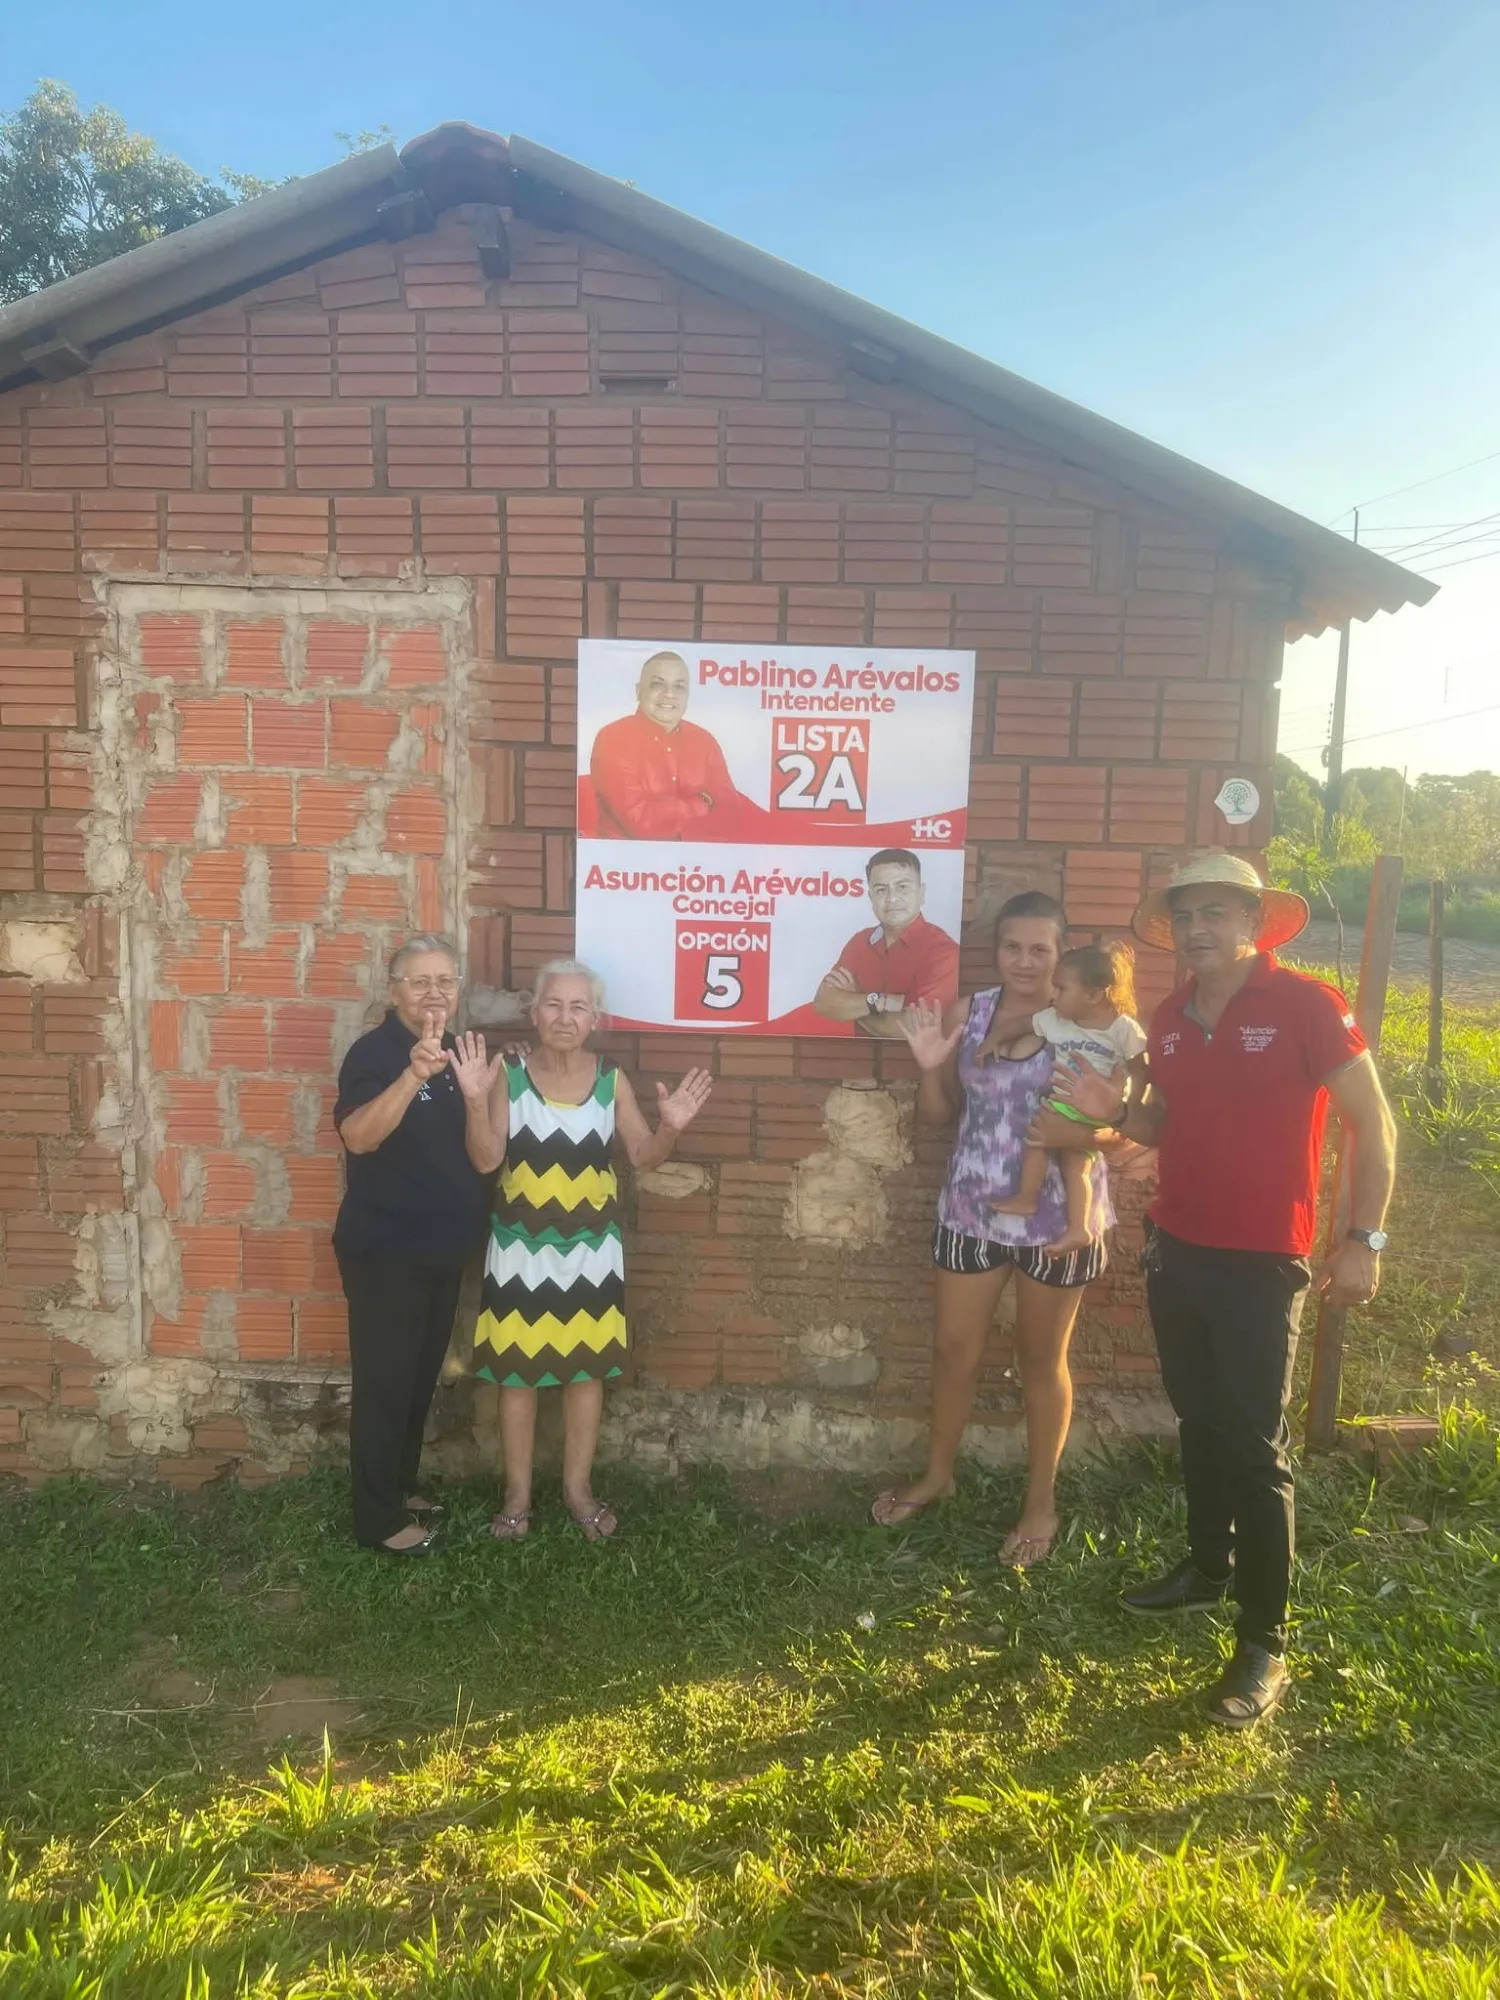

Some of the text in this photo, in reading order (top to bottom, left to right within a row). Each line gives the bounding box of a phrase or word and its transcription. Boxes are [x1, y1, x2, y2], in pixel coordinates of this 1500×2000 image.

[699, 660, 960, 692] Pablino Arévalos
[761, 690, 896, 713] Intendente
[777, 724, 866, 752] LISTA
[777, 753, 866, 811] 2A
[584, 865, 864, 897] Asunción Arévalos
[672, 895, 775, 920] Concejal
[677, 928, 769, 952] OPCIÓN
[701, 954, 744, 1010] 5
